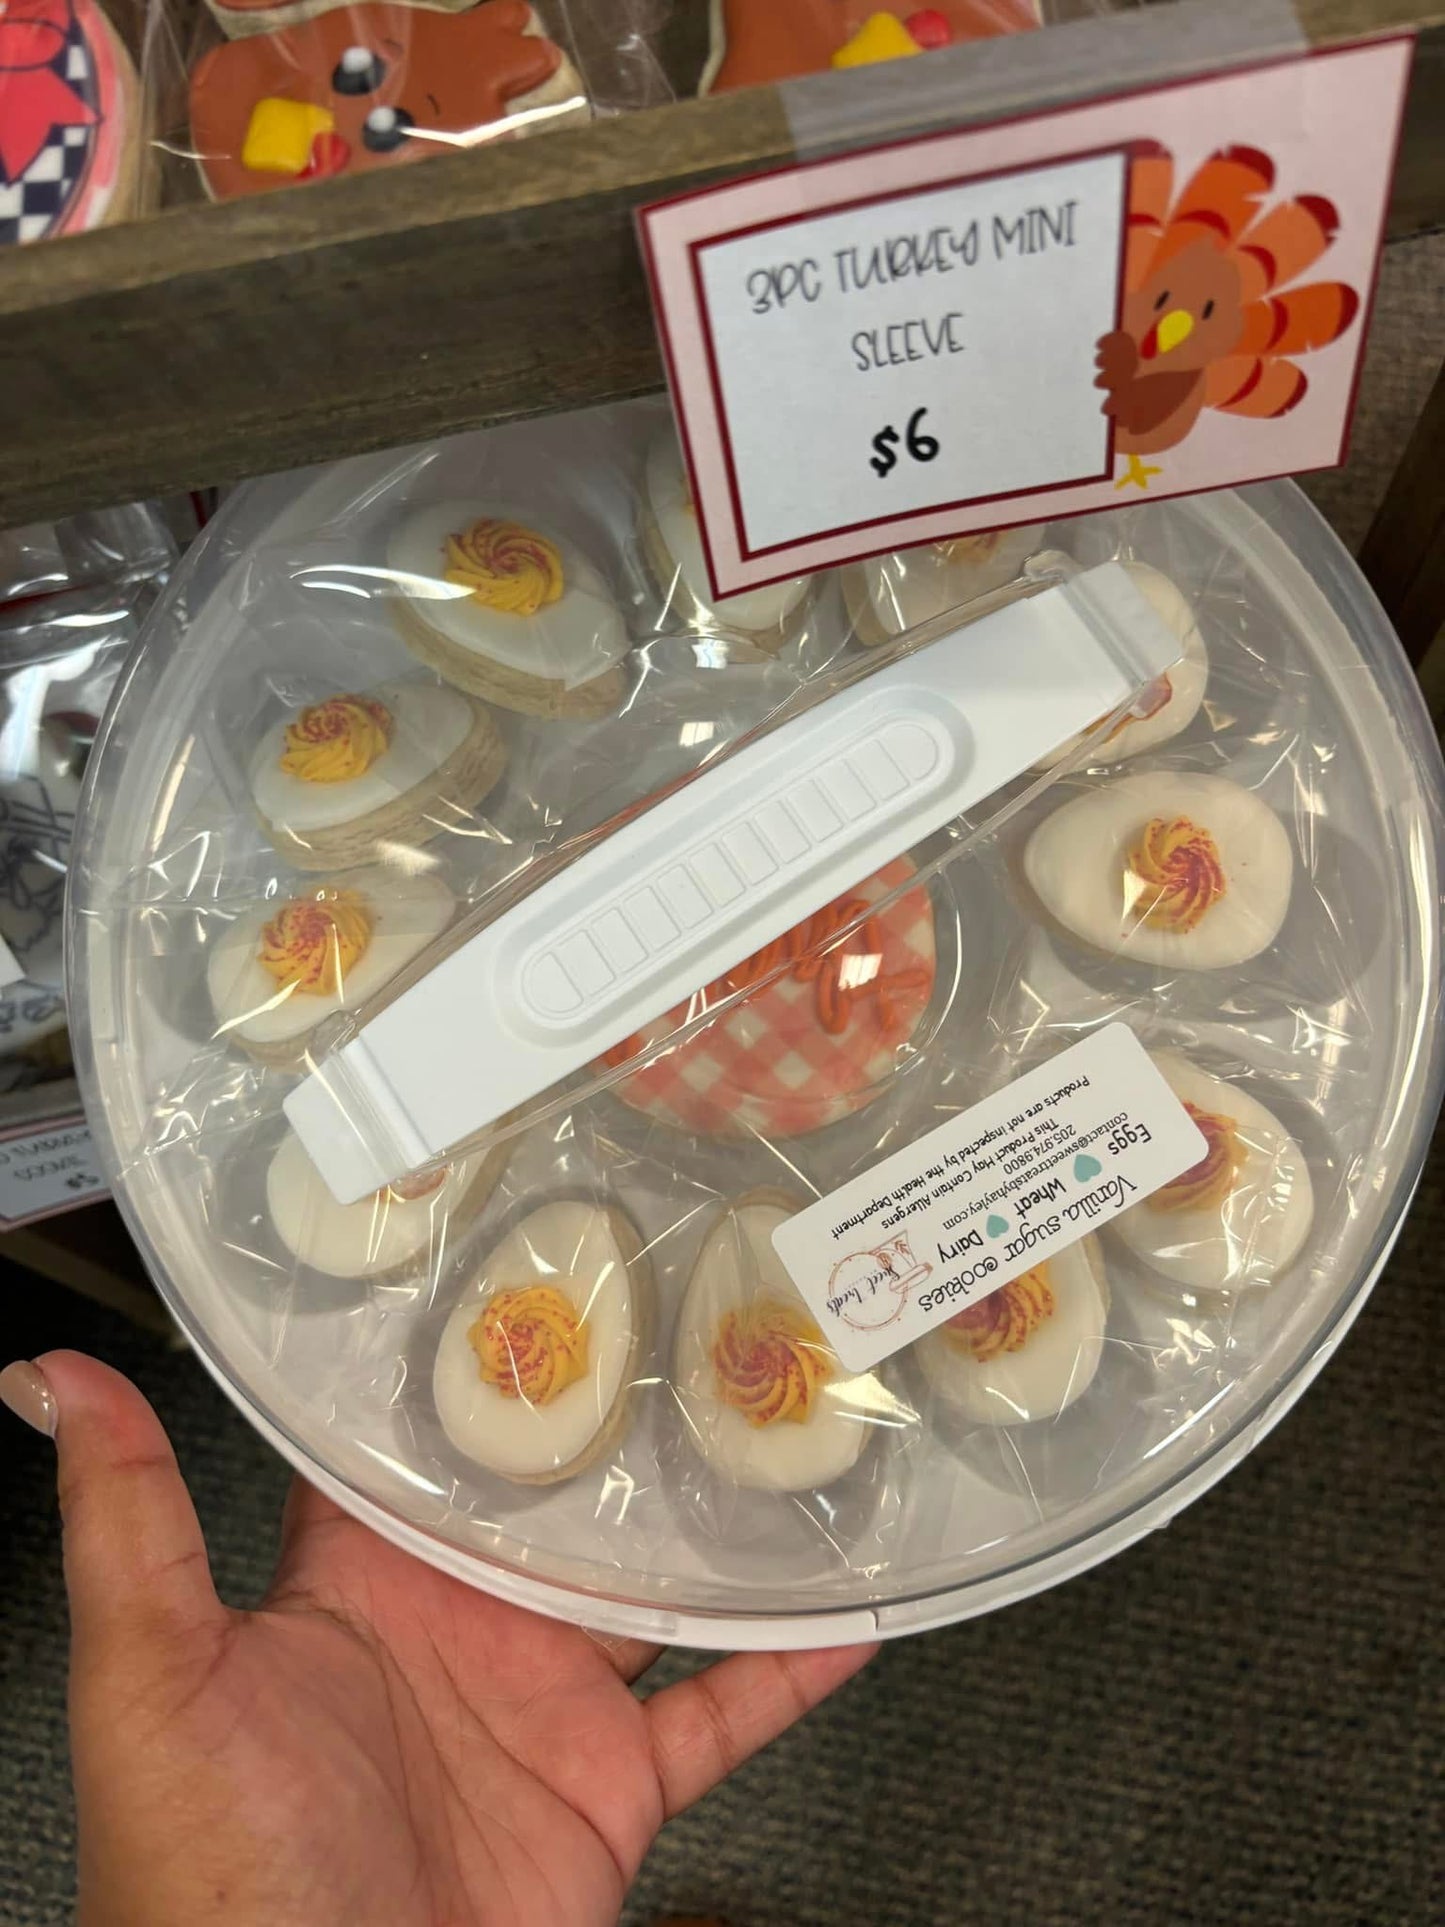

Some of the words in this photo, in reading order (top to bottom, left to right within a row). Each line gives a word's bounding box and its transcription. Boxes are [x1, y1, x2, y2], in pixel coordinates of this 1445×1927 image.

[746, 258, 821, 314] 3PC
[834, 219, 978, 294] TURKEY
[993, 200, 1077, 261] MINI
[851, 312, 965, 372] SLEEVE
[869, 406, 941, 479] $6
[1043, 1075, 1090, 1107] Products
[1006, 1113, 1024, 1130] not
[1025, 1102, 1043, 1118] are
[1034, 1116, 1059, 1136] This
[958, 1125, 1005, 1159] inspected
[994, 1131, 1033, 1160] Product
[1002, 1124, 1076, 1175] 205.974.9800
[1107, 1123, 1152, 1156] Eggs
[926, 1165, 943, 1182] the
[942, 1112, 1128, 1231] contact@sweettreatsbyhayley.com
[943, 1153, 958, 1169] by
[974, 1154, 994, 1174] May
[891, 1171, 924, 1200] Health
[931, 1170, 972, 1198] Contain
[1013, 1178, 1066, 1219] Wheat
[1062, 1174, 1137, 1221] Vanilla
[830, 1196, 891, 1239] Department
[881, 1196, 931, 1230] Allergens
[937, 1229, 983, 1263] Dairy
[1004, 1215, 1061, 1262] sugar
[867, 1266, 900, 1295] Sweet
[918, 1257, 998, 1311] cookies
[826, 1288, 862, 1317] treats
